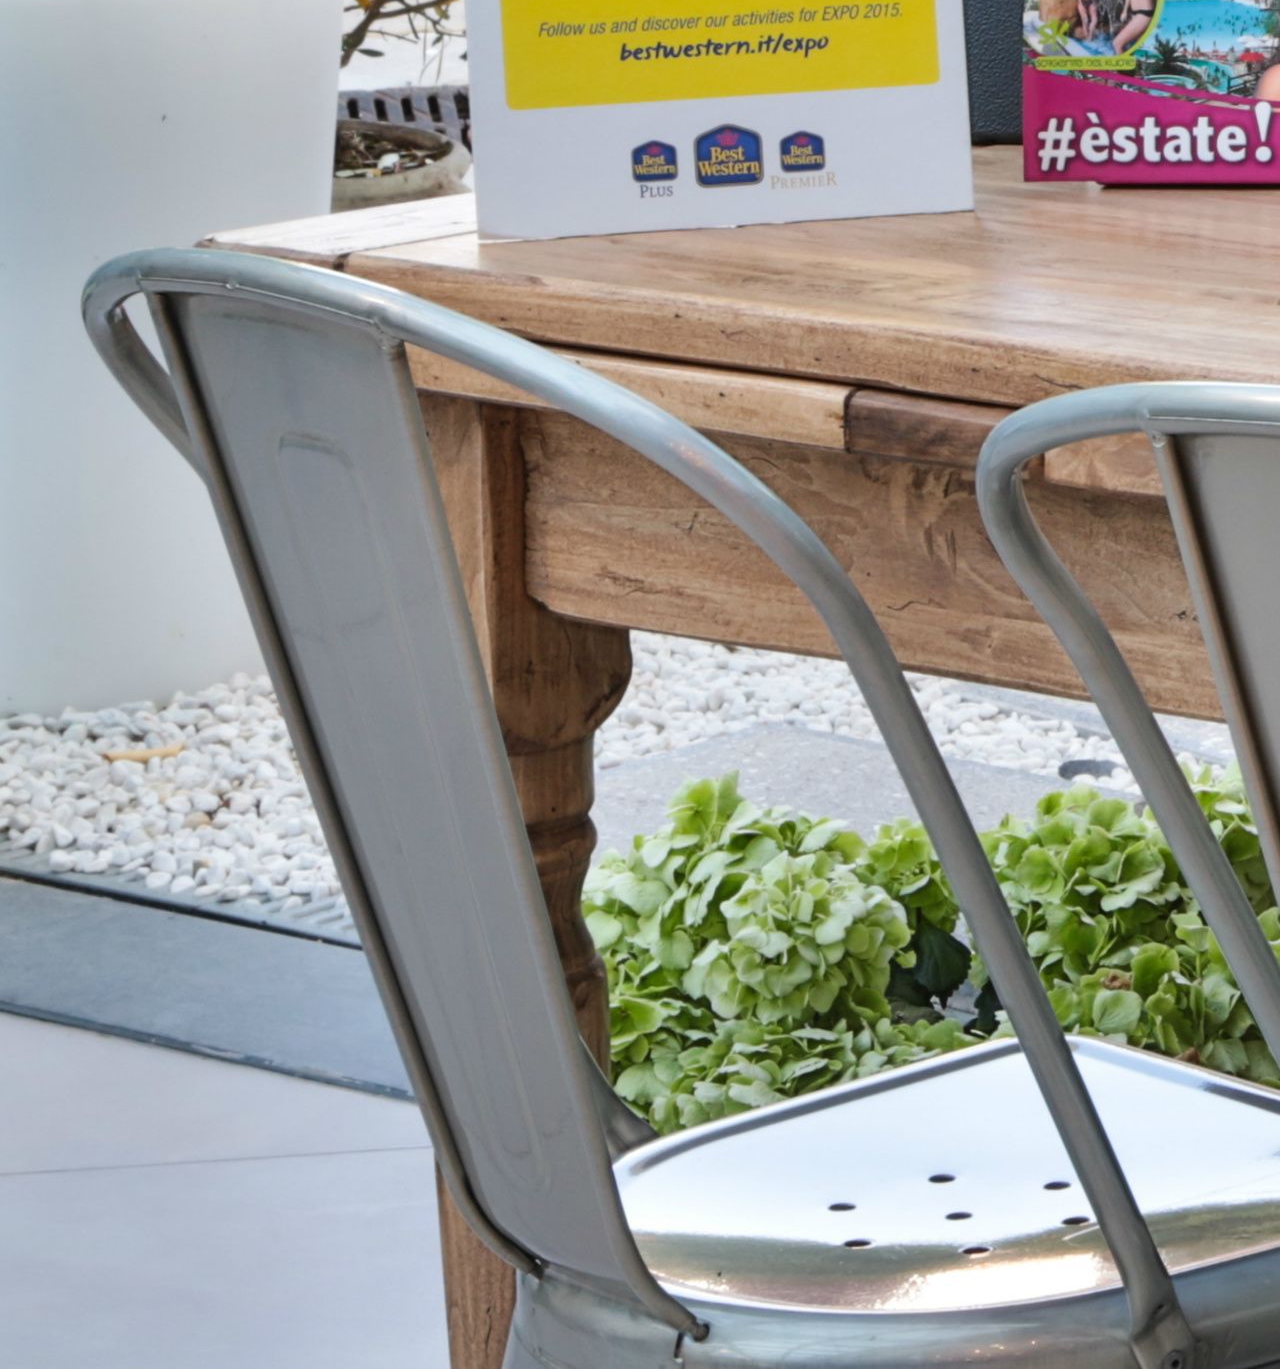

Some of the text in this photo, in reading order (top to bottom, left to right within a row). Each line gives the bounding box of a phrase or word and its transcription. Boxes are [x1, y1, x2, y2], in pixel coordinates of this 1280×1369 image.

[539, 3, 903, 37] Follow us and discover our activities for EXPO 2015.
[620, 33, 829, 61] bestwestern.it/expo
[1037, 101, 1274, 172] #èstate!
[710, 146, 745, 162] Best
[790, 145, 813, 156] Best
[642, 155, 665, 166] Best
[782, 154, 823, 165] Western
[634, 164, 675, 175] Western
[698, 161, 760, 177] Western
[770, 172, 838, 189] PREMIER
[640, 184, 674, 198] PLUS
